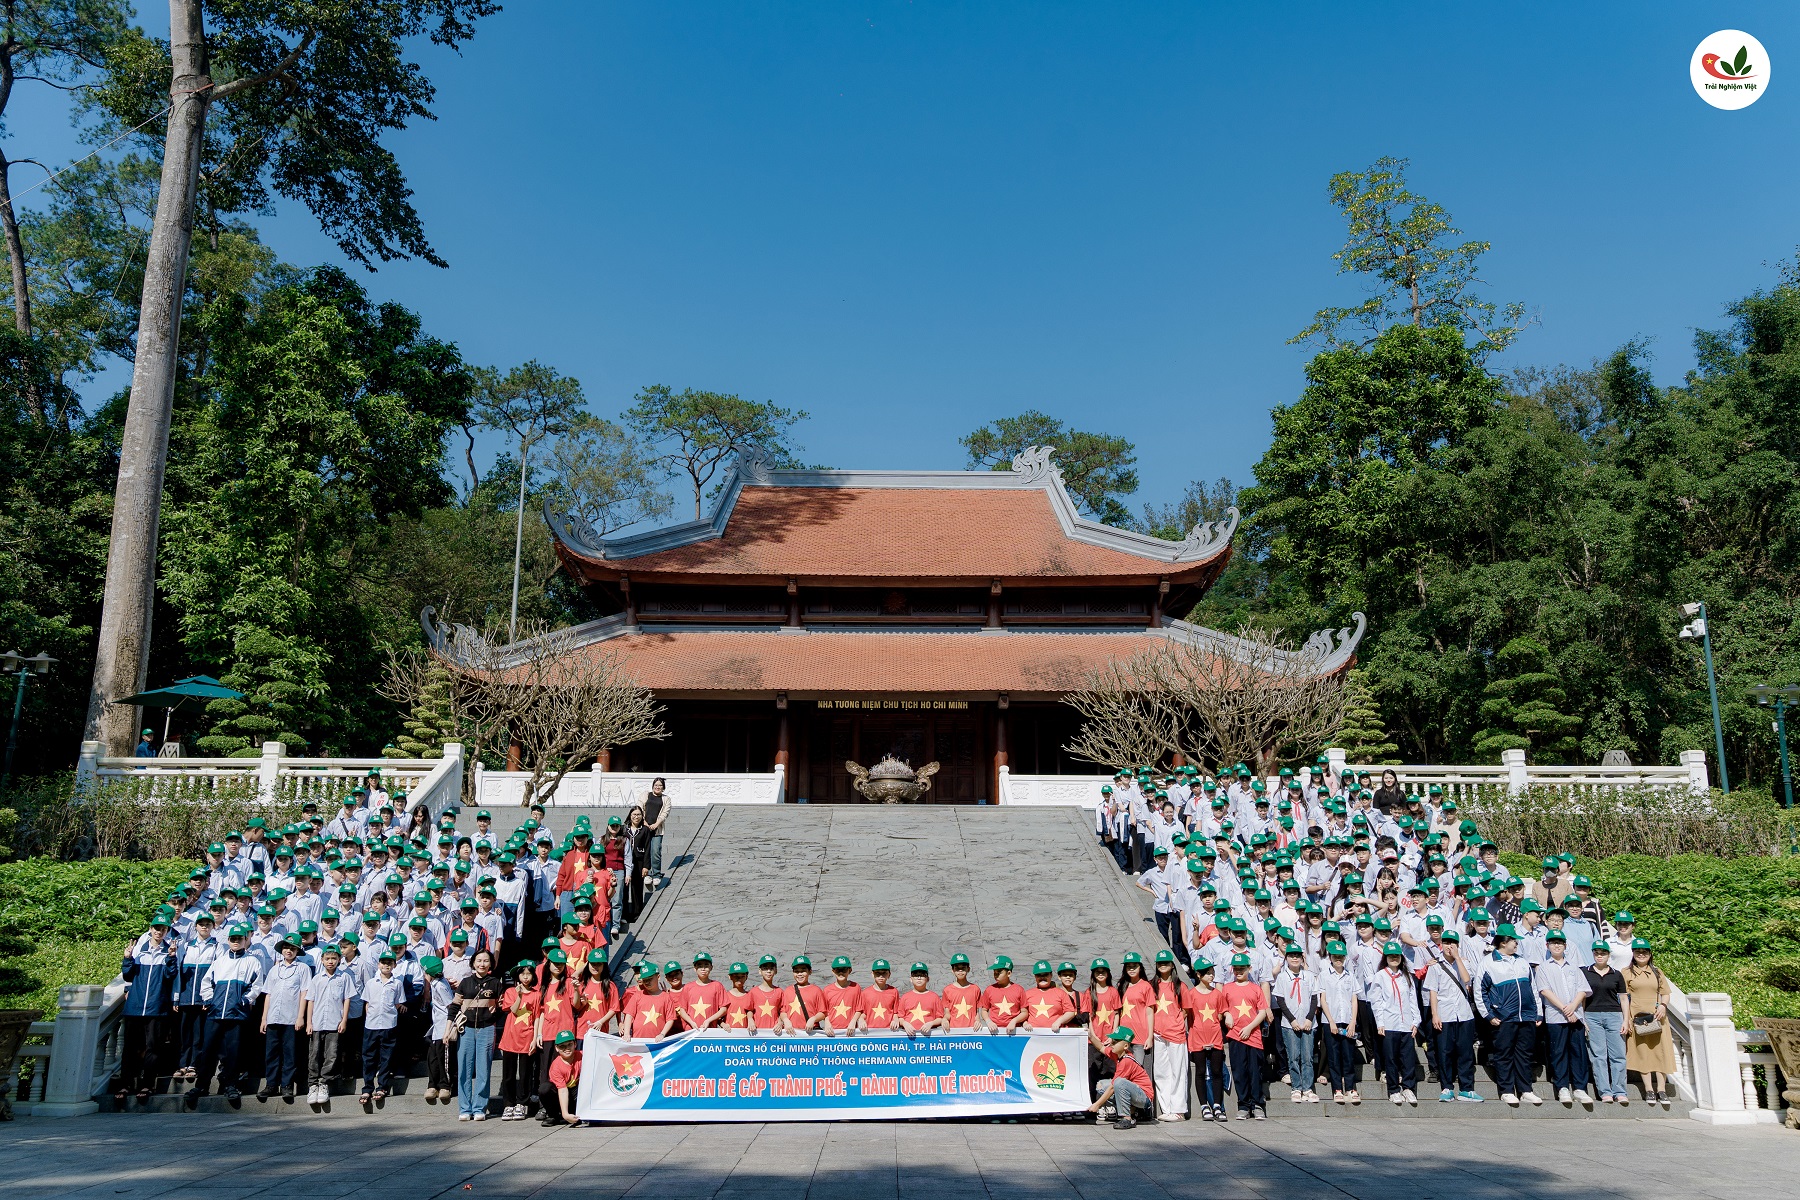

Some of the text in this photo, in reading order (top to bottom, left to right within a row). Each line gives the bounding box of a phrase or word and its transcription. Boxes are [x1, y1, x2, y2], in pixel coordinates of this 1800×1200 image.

[948, 701, 968, 710] MINH
[725, 1045, 751, 1053] TNCS
[770, 1043, 787, 1053] CHÍ
[789, 1044, 814, 1053] MINH
[817, 1042, 858, 1052] PHƯỜNG
[913, 1043, 927, 1051] TP.
[949, 1040, 983, 1050] PHÒNG
[756, 1055, 797, 1066] TRƯỜNG
[822, 1055, 855, 1065] THÔNG
[858, 1056, 907, 1065] HERMANN
[909, 1055, 952, 1064] GMEINER
[662, 1075, 716, 1098] CHUYÊN
[718, 1073, 737, 1098] ĐỀ
[739, 1072, 767, 1097] CẤP
[769, 1074, 813, 1097] THÀNH
[815, 1071, 847, 1096] PHỐ:
[861, 1073, 898, 1096] HÀNH
[900, 1072, 937, 1097] QUÂN
[939, 1070, 957, 1094] VỀ
